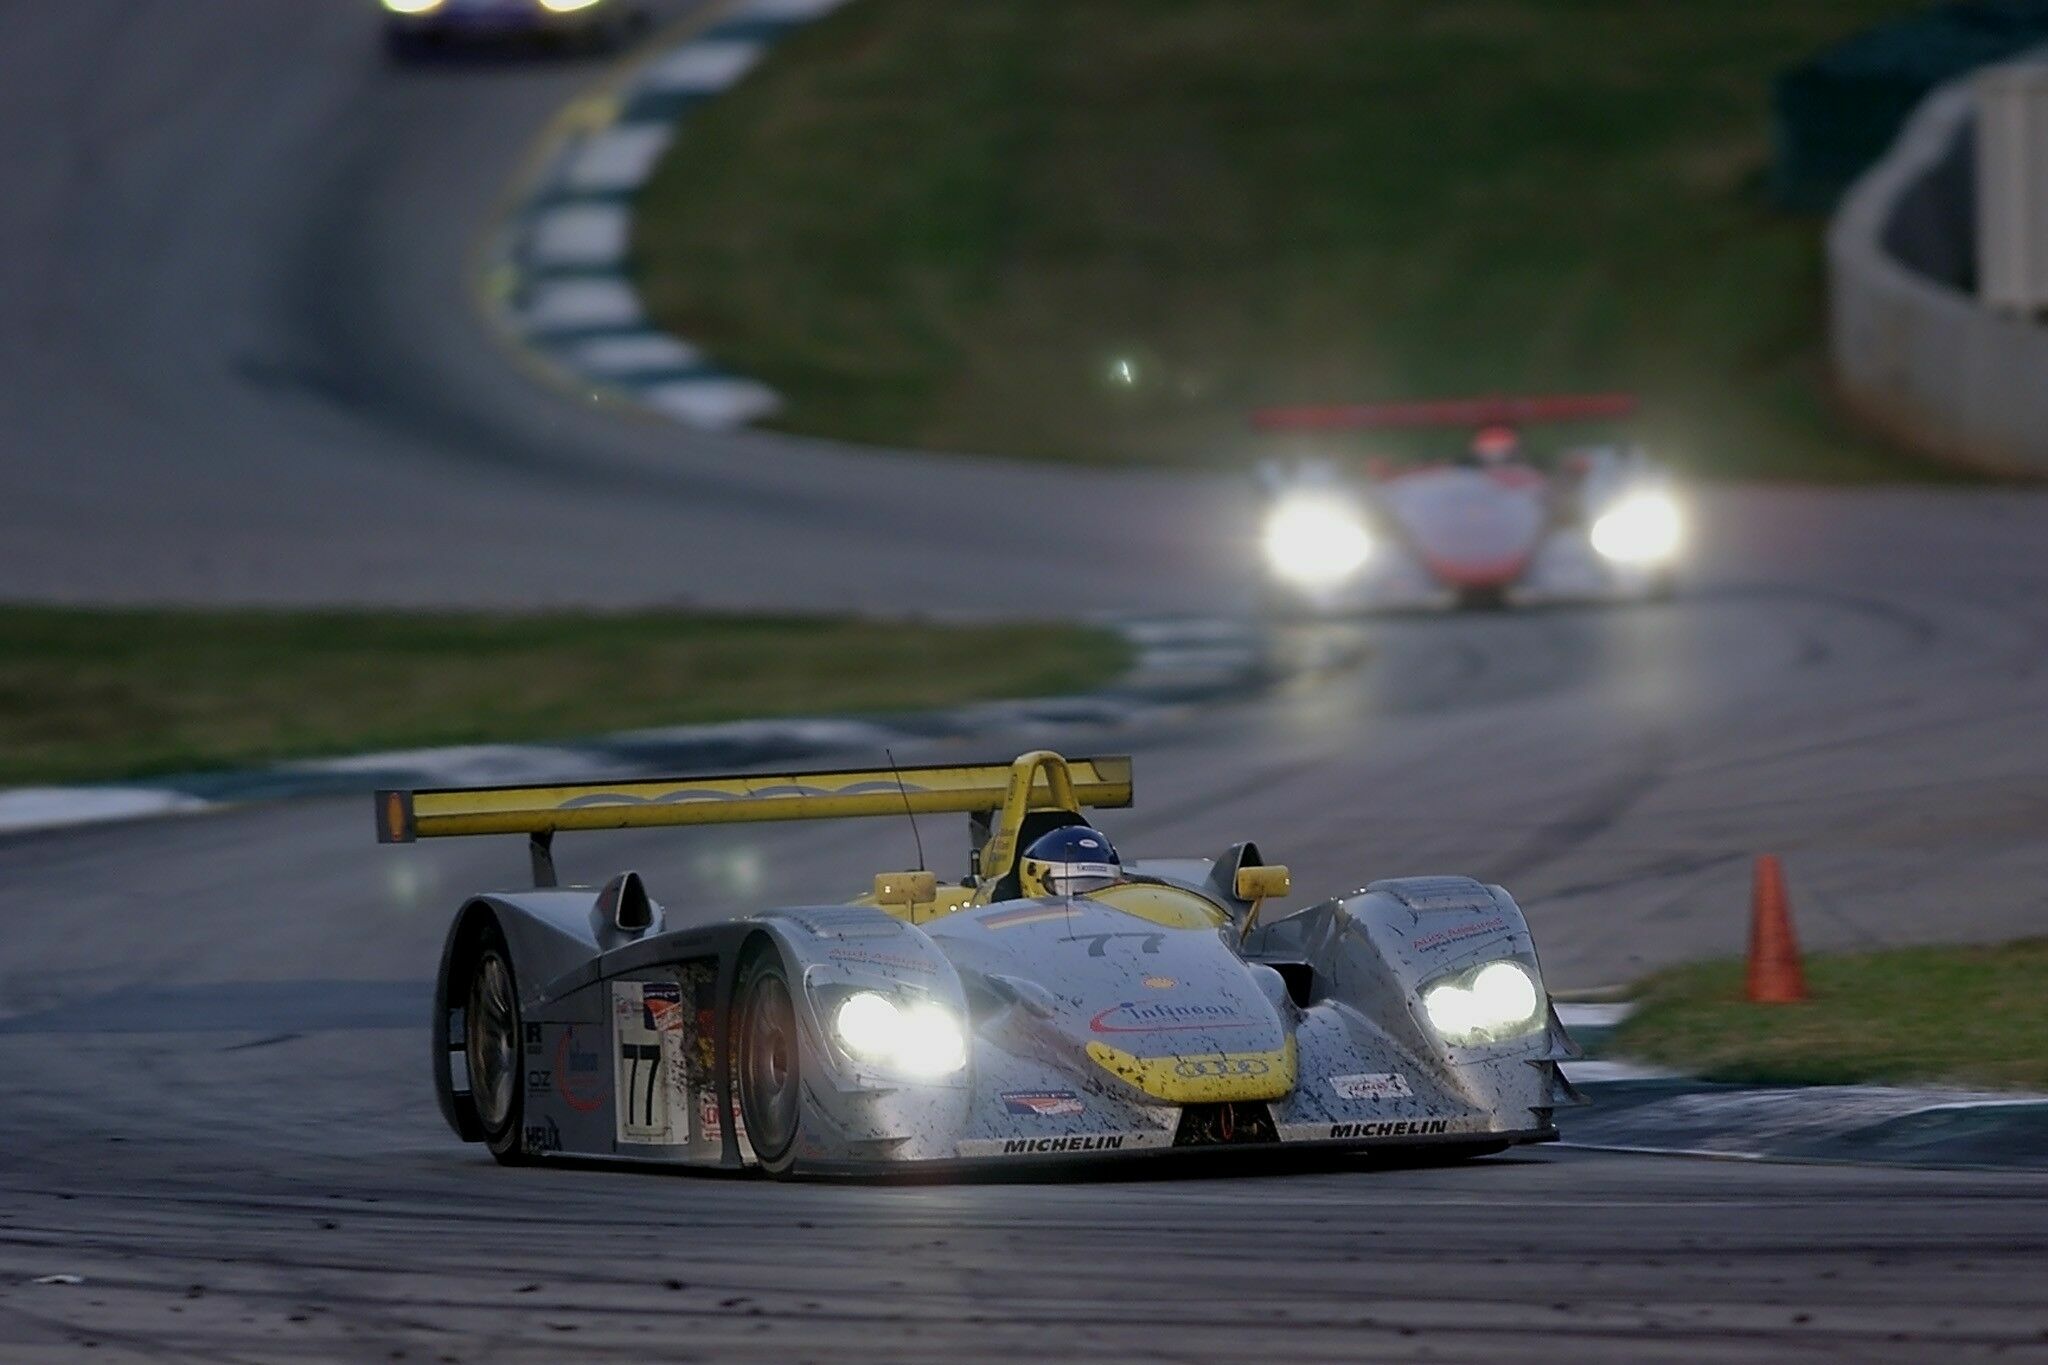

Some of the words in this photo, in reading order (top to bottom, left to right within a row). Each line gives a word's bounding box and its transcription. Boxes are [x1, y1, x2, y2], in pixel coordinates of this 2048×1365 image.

[1057, 932, 1166, 957] 77
[622, 1043, 661, 1126] 77
[1331, 1120, 1448, 1138] MICHELIN
[1003, 1136, 1123, 1153] MICHELIN
